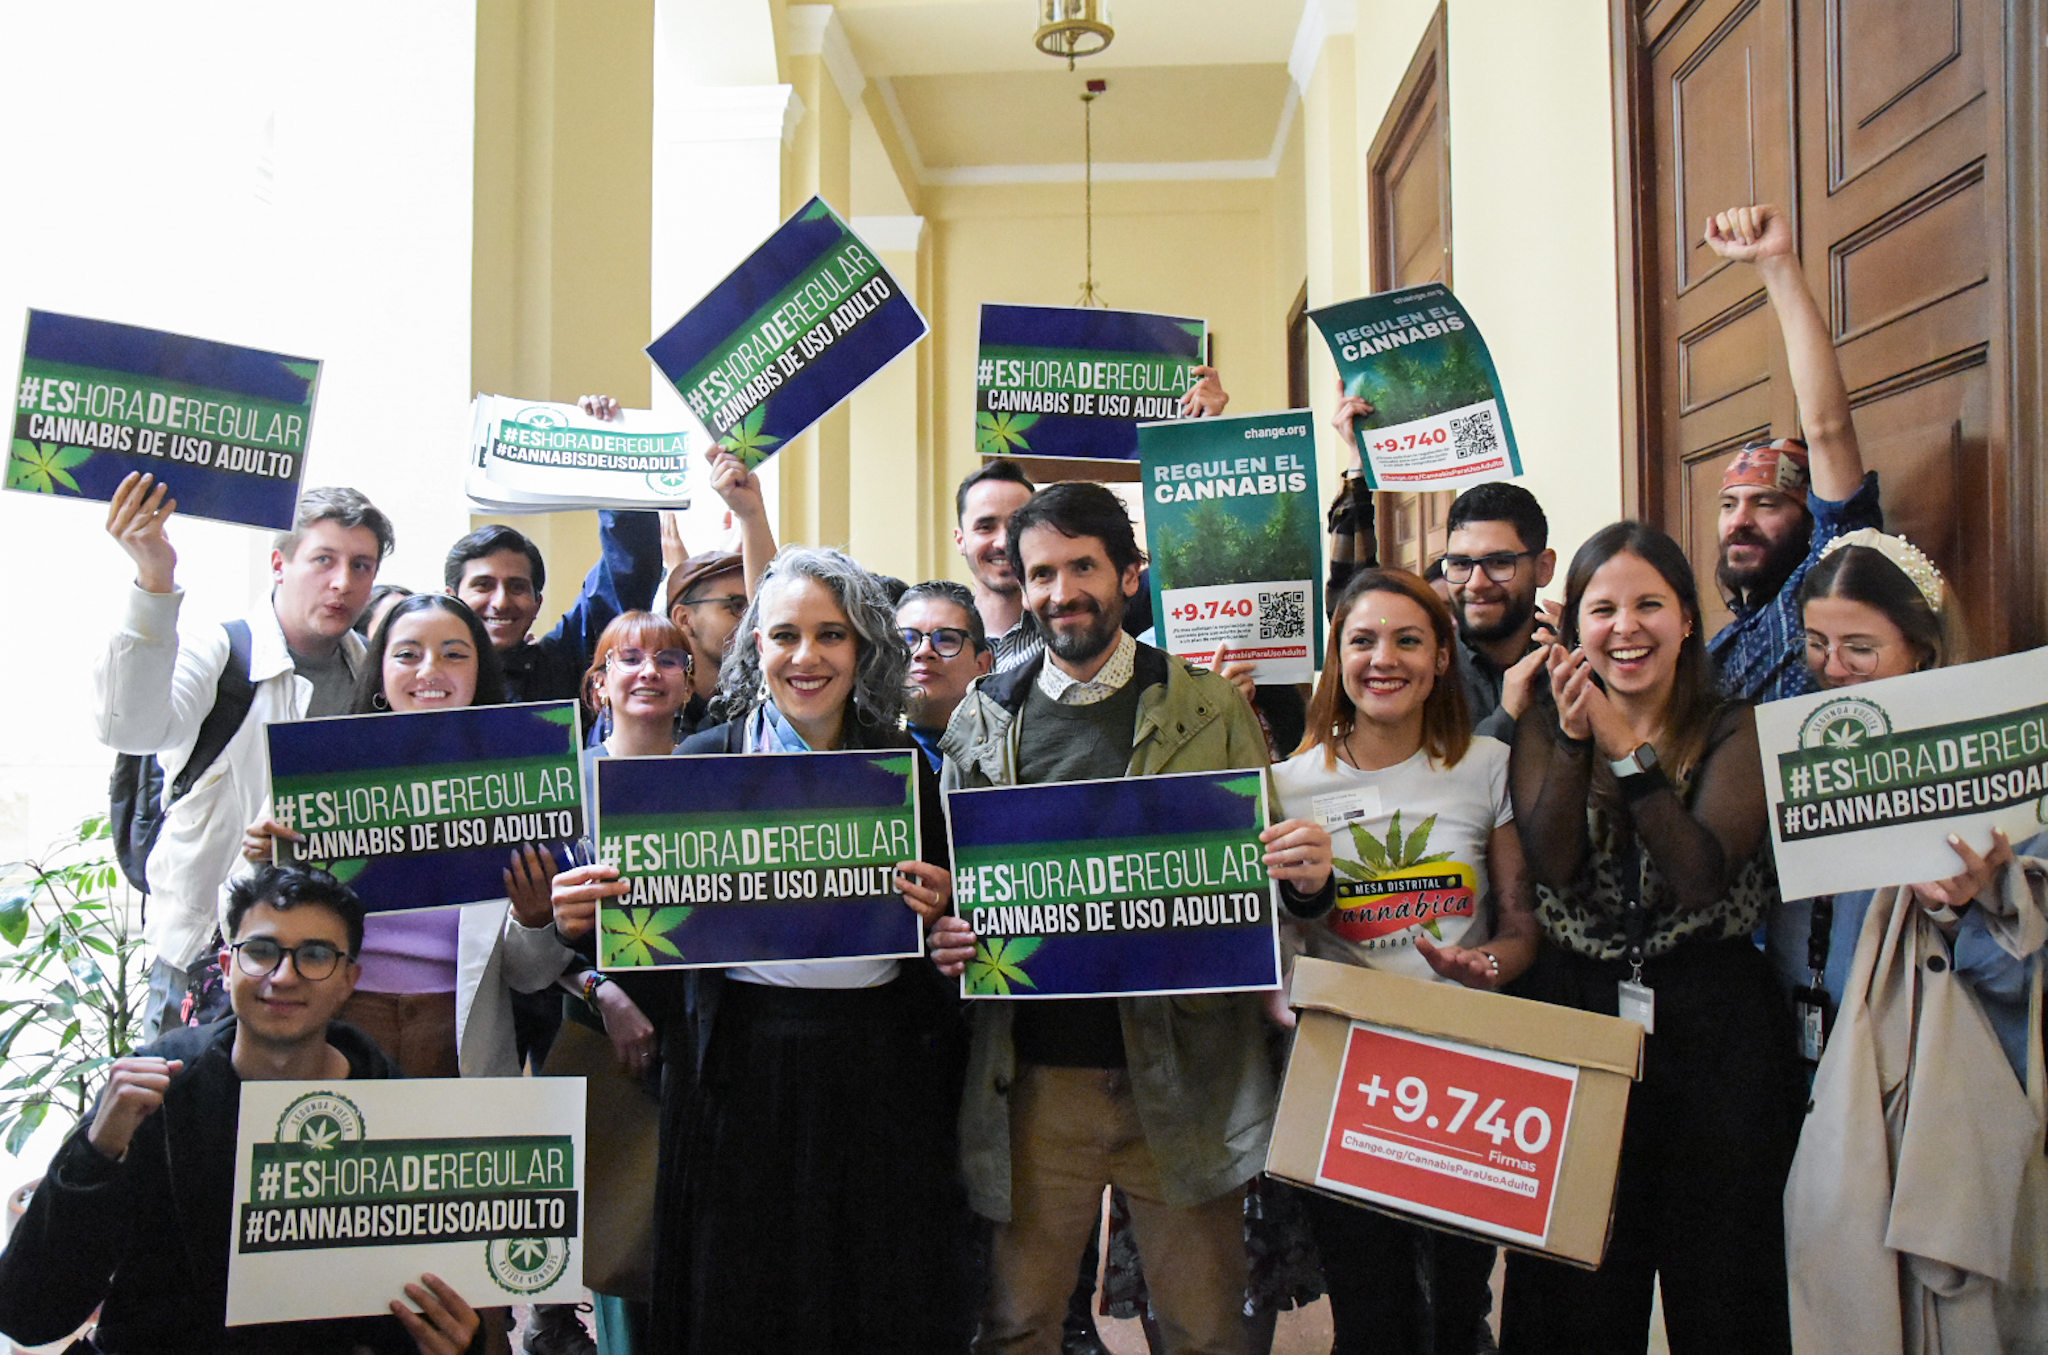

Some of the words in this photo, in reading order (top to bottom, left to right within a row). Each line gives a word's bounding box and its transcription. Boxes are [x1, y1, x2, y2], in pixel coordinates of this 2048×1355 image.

[1393, 289, 1445, 305] change.org
[687, 244, 874, 419] #ESHORADEREGULAR
[1335, 311, 1426, 346] REGULEN
[1429, 305, 1457, 320] EL
[1342, 316, 1465, 362] CANNABIS
[712, 363, 784, 433] CANNABIS
[776, 346, 805, 378] DE
[797, 322, 834, 360] USO
[829, 276, 890, 336] ADULTO
[19, 376, 302, 447] #ESHORADEREGULAR
[987, 389, 1069, 414] CANNABIS
[1073, 393, 1094, 415] DE
[1099, 395, 1131, 416] USO
[1133, 396, 1182, 419] ADULT
[29, 413, 134, 451] CANNABIS
[137, 428, 164, 457] DE
[170, 435, 211, 466] USO
[215, 444, 293, 479] ADULTO
[1245, 425, 1307, 440] change.org
[1373, 428, 1447, 453] +9.740
[496, 442, 687, 470] #CANNABISDEUSOADULT
[1154, 456, 1268, 482] REGULEN
[1275, 454, 1305, 471] EL
[1154, 472, 1307, 504] CANNABIS
[1172, 599, 1253, 622] +9.740
[1812, 706, 1849, 732] SEGUNDA
[1853, 707, 1878, 730] VUELTA
[275, 766, 575, 830] #ESHORADEREGULAR
[293, 825, 403, 861] CANNABIS
[411, 822, 439, 851] DE
[445, 817, 487, 848] USO
[493, 810, 573, 843] ADULTO
[601, 819, 909, 872] #ESHORADEREGULAR
[617, 872, 732, 906] CANNABIS
[739, 872, 767, 901] DE
[774, 869, 817, 900] USO
[957, 843, 1262, 904] #ESHORADEREGULAR
[1355, 883, 1384, 895] MESA
[1387, 879, 1441, 891] DISTRITAL
[972, 903, 1080, 936] CANNABIS
[1086, 900, 1116, 931] DE
[1120, 898, 1166, 929] USO
[1172, 892, 1260, 927] ADULTO
[291, 1101, 329, 1126] SEGUNDA
[332, 1104, 353, 1132] VUELTA
[1358, 1073, 1552, 1154] +9.740
[258, 1148, 565, 1201] #ESHORADEREGULAR
[1344, 1134, 1536, 1193] Change.org/CannabisParaUsoAdulto
[1488, 1150, 1537, 1173] Firmas
[246, 1198, 565, 1243] #CANNABISDEUSOADULTO
